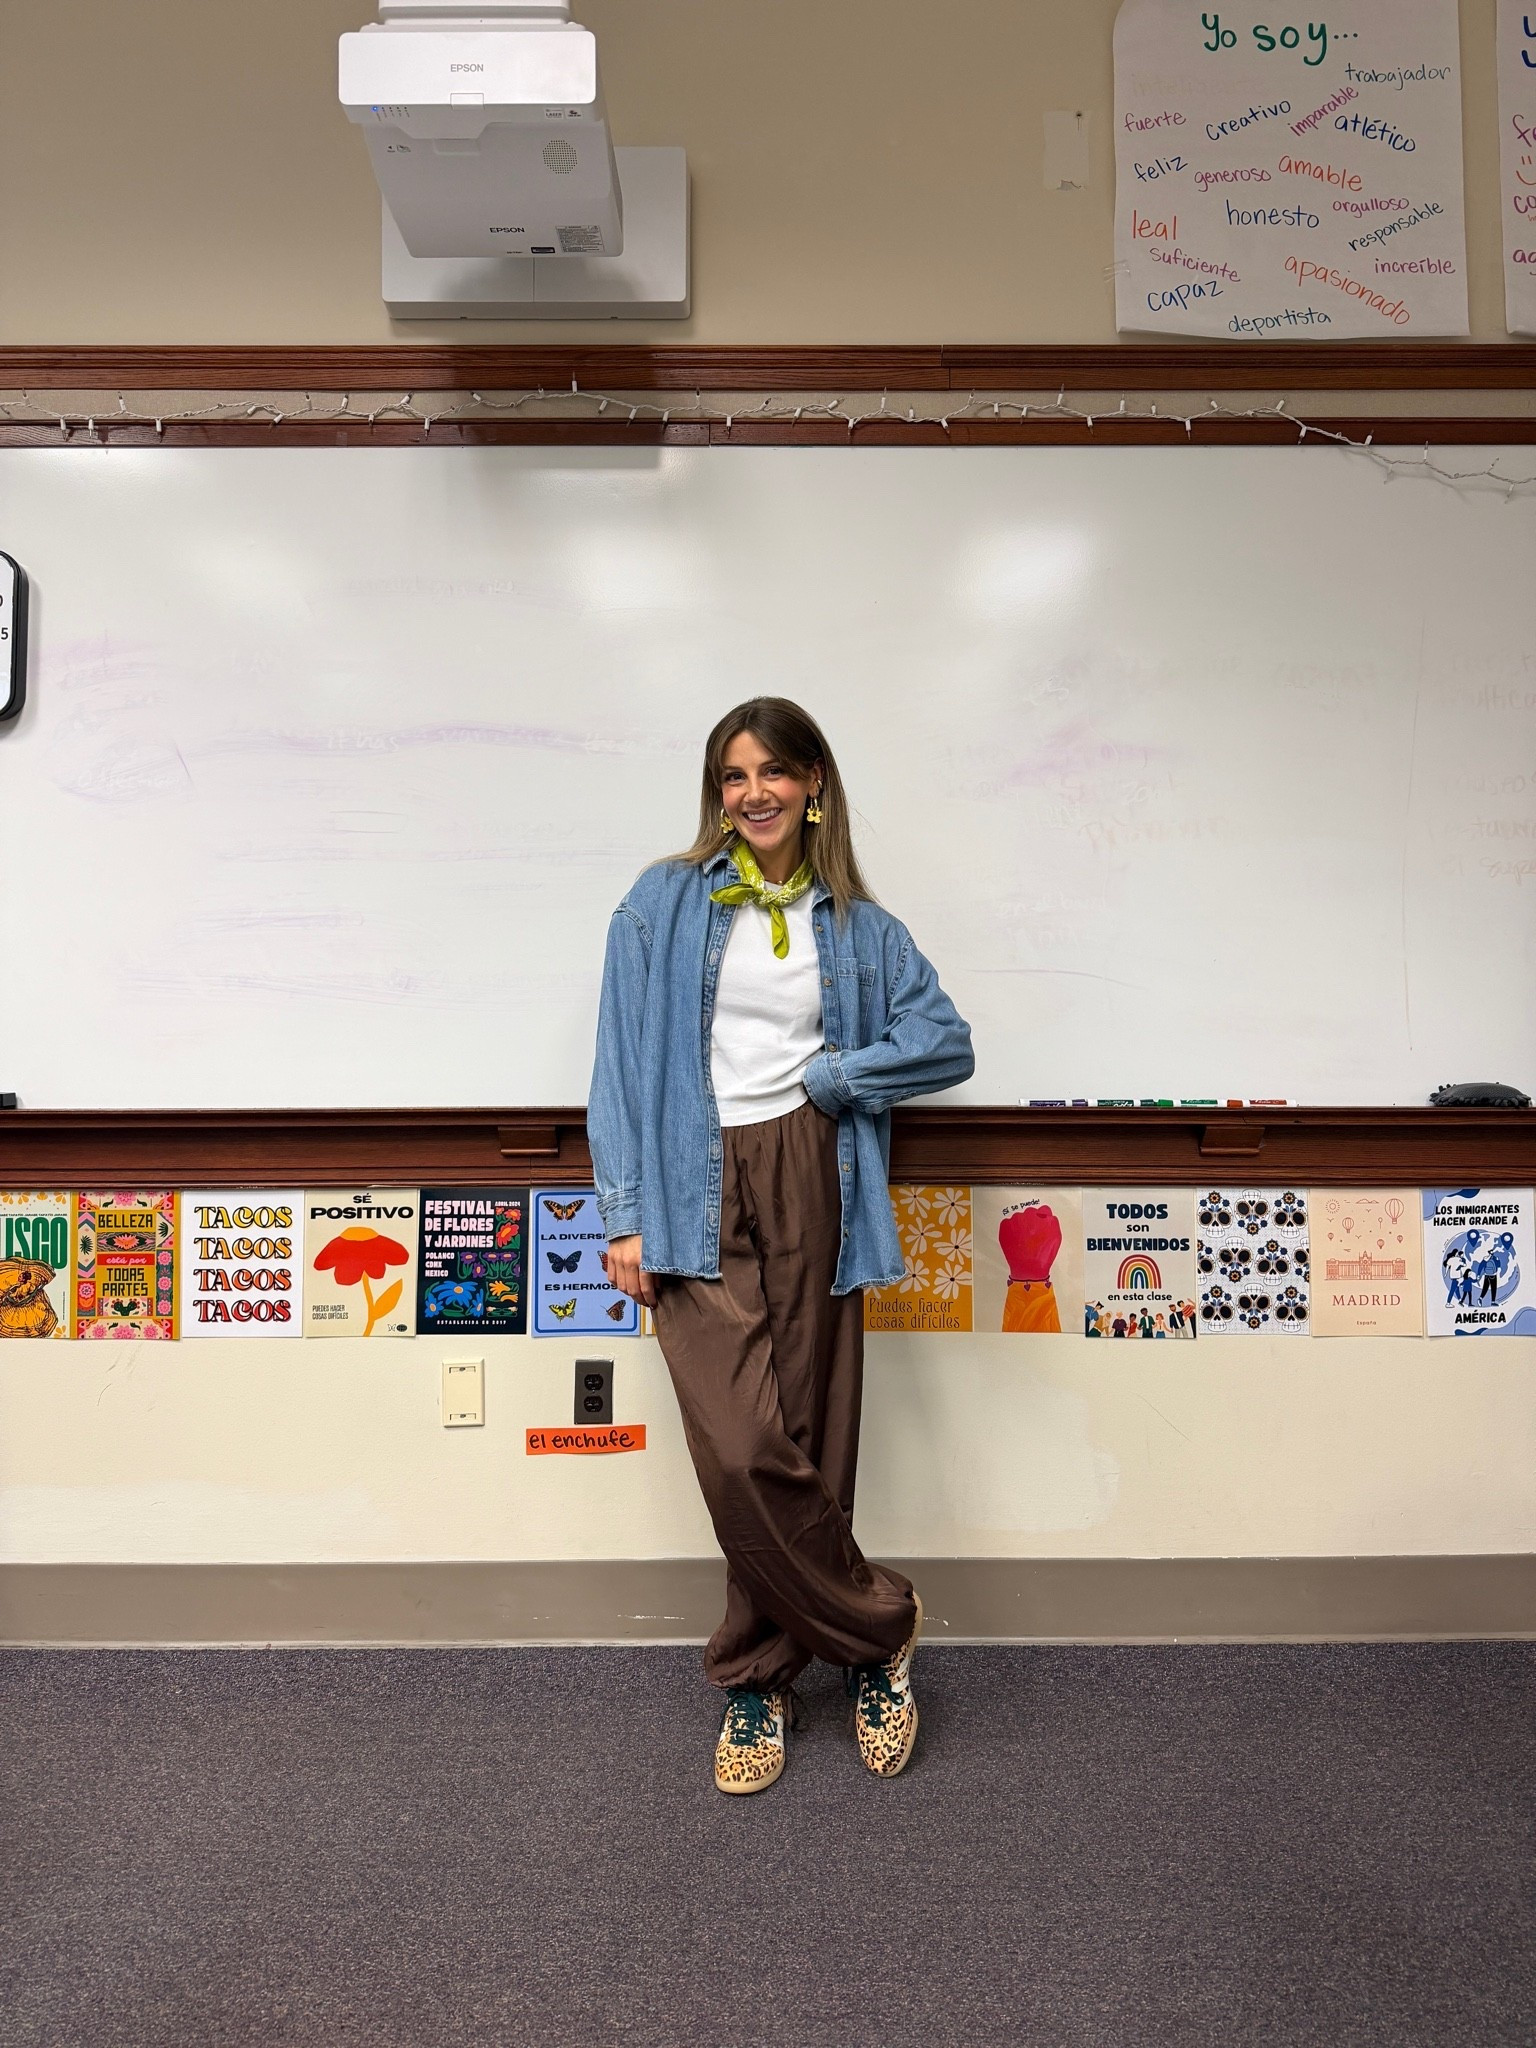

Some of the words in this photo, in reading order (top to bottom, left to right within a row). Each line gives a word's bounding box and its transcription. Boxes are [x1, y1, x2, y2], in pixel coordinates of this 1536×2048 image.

[450, 63, 484, 72] EPSON
[1344, 62, 1452, 91] trabajador
[1289, 84, 1360, 137] imparable
[1123, 110, 1188, 134] fuerte
[1334, 113, 1417, 153] atlético
[1134, 155, 1189, 184] feliz
[1278, 154, 1364, 192] amable
[1193, 166, 1273, 193] generoso
[1225, 199, 1321, 229] honesto
[1332, 195, 1411, 219] orgulloso
[1132, 209, 1179, 241] leal
[1348, 200, 1445, 253] responsable
[1149, 246, 1242, 284] suficiente
[1373, 256, 1458, 276] increíble
[1284, 255, 1411, 325] apasionado
[1227, 306, 1333, 337] deportista
[353, 1192, 372, 1204] SÉ
[310, 1206, 414, 1220] POSITIVO
[425, 1200, 495, 1215] FESTIVAL
[1106, 1203, 1168, 1219] TODOS
[1435, 1206, 1453, 1215] LOS
[1455, 1204, 1520, 1214] INMIGRANTES
[98, 1214, 153, 1228] BELLEZA
[193, 1206, 293, 1228] TACOS
[424, 1218, 441, 1231] DE
[444, 1218, 494, 1231] FLORES
[1433, 1216, 1466, 1226] HACEN
[1469, 1216, 1508, 1225] GRANDE
[1511, 1216, 1519, 1225] A
[1126, 1224, 1150, 1232] son
[5, 1216, 67, 1269] ISCO
[193, 1237, 292, 1259] TACOS
[424, 1235, 433, 1248] Y
[434, 1235, 494, 1248] JARDINES
[1086, 1238, 1190, 1251] BIENVENIDOS
[105, 1256, 127, 1265] está
[425, 1252, 455, 1260] POLANCO
[106, 1268, 145, 1281] TODAS
[192, 1269, 292, 1291] TACOS
[102, 1283, 148, 1296] PARTES
[562, 1283, 618, 1291] HERMOS
[1122, 1292, 1144, 1301] esta
[1146, 1291, 1172, 1301] clase
[1332, 1294, 1401, 1306] MADRID
[192, 1299, 291, 1322] TACOS
[312, 1304, 330, 1312] PUEDES
[869, 1297, 912, 1312] Puedes
[918, 1297, 954, 1312] hacer
[312, 1312, 328, 1320] COSAS
[869, 1315, 905, 1328] cosas
[910, 1313, 960, 1328] difíciles
[1454, 1309, 1507, 1324] AMÉRICA
[529, 1433, 546, 1449] el
[551, 1428, 636, 1448] enchufe
